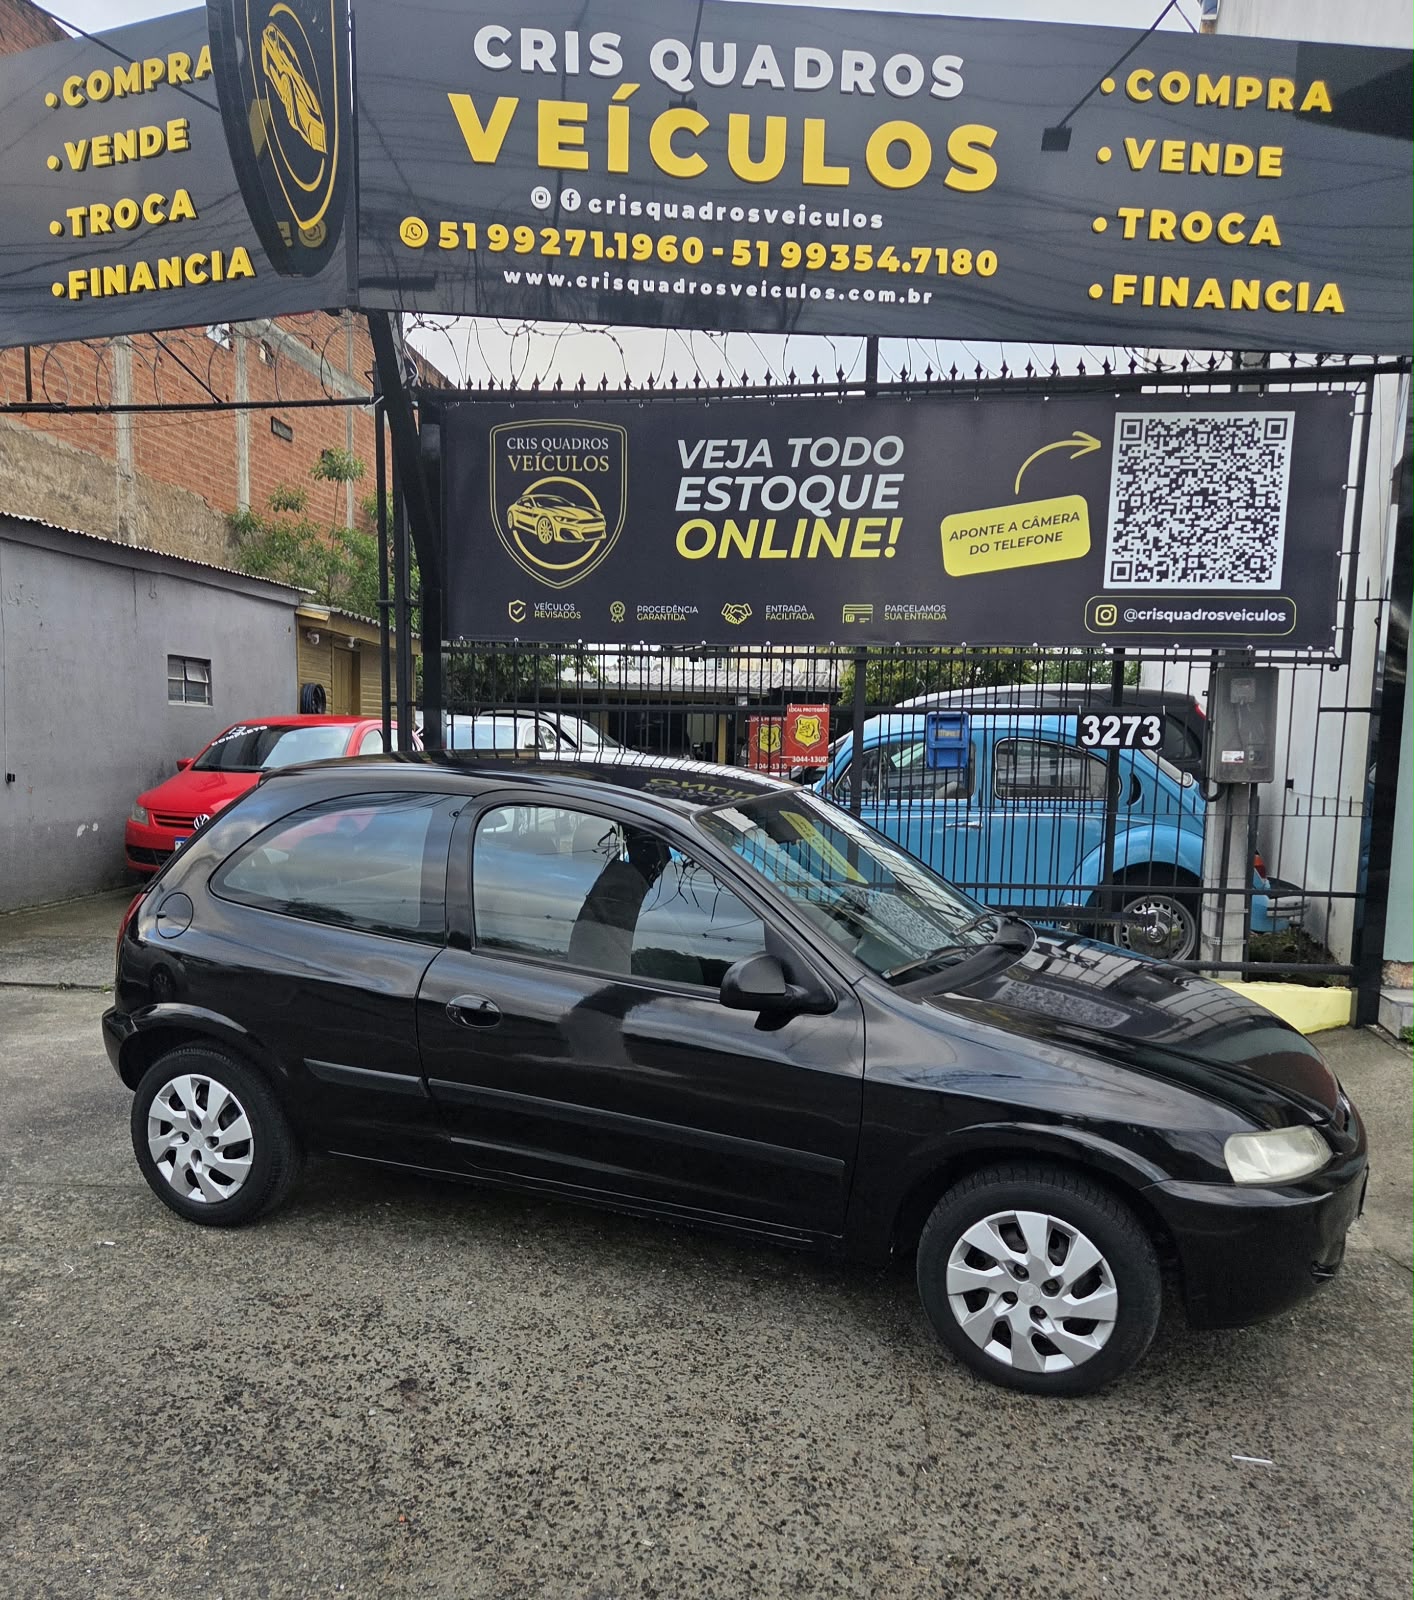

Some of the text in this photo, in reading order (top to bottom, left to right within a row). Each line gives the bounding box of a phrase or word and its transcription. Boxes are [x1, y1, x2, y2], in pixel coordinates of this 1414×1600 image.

[62, 46, 213, 108] COMPRA
[473, 24, 965, 98] CRIS QUADROS
[1126, 69, 1333, 113] COMPRA
[64, 118, 190, 171] VENDE
[447, 83, 998, 192] VEÍCULOS
[1124, 137, 1284, 178] VENDE
[66, 189, 197, 237] TROCA
[588, 193, 883, 229] crisquadrosveiculos
[1118, 207, 1281, 247] TROCA
[438, 221, 477, 250] 51
[487, 224, 704, 264] 99271.1960
[731, 239, 769, 268] 51
[780, 241, 998, 276] 99354.7180
[68, 246, 255, 300] FINANCIA
[503, 270, 933, 304] www.crisquadrosveiculos.com.br
[1111, 274, 1345, 314] FINANCIA
[506, 437, 609, 452] CRIS QUADROS
[677, 435, 904, 469] VEJA TODO
[508, 452, 610, 472] VEÍCULOS
[675, 473, 905, 518] ESTOQUE
[675, 517, 904, 560] ONLINE!
[949, 511, 1080, 541] APONTE A CÂMERA
[969, 531, 1064, 555] DO TELEFONE
[534, 602, 575, 611] VEÍCULOS
[534, 611, 582, 619] REVISADOS
[636, 613, 686, 621] GARANTIDA
[637, 604, 699, 614] PROCEDÊNCIA
[765, 613, 815, 621] FACILITADA
[884, 604, 947, 613] PARCELAMOS
[884, 612, 947, 621] SUA ENTRADA
[1123, 607, 1287, 624] @crisquadrosveiculos
[1081, 715, 1161, 746] 3273
